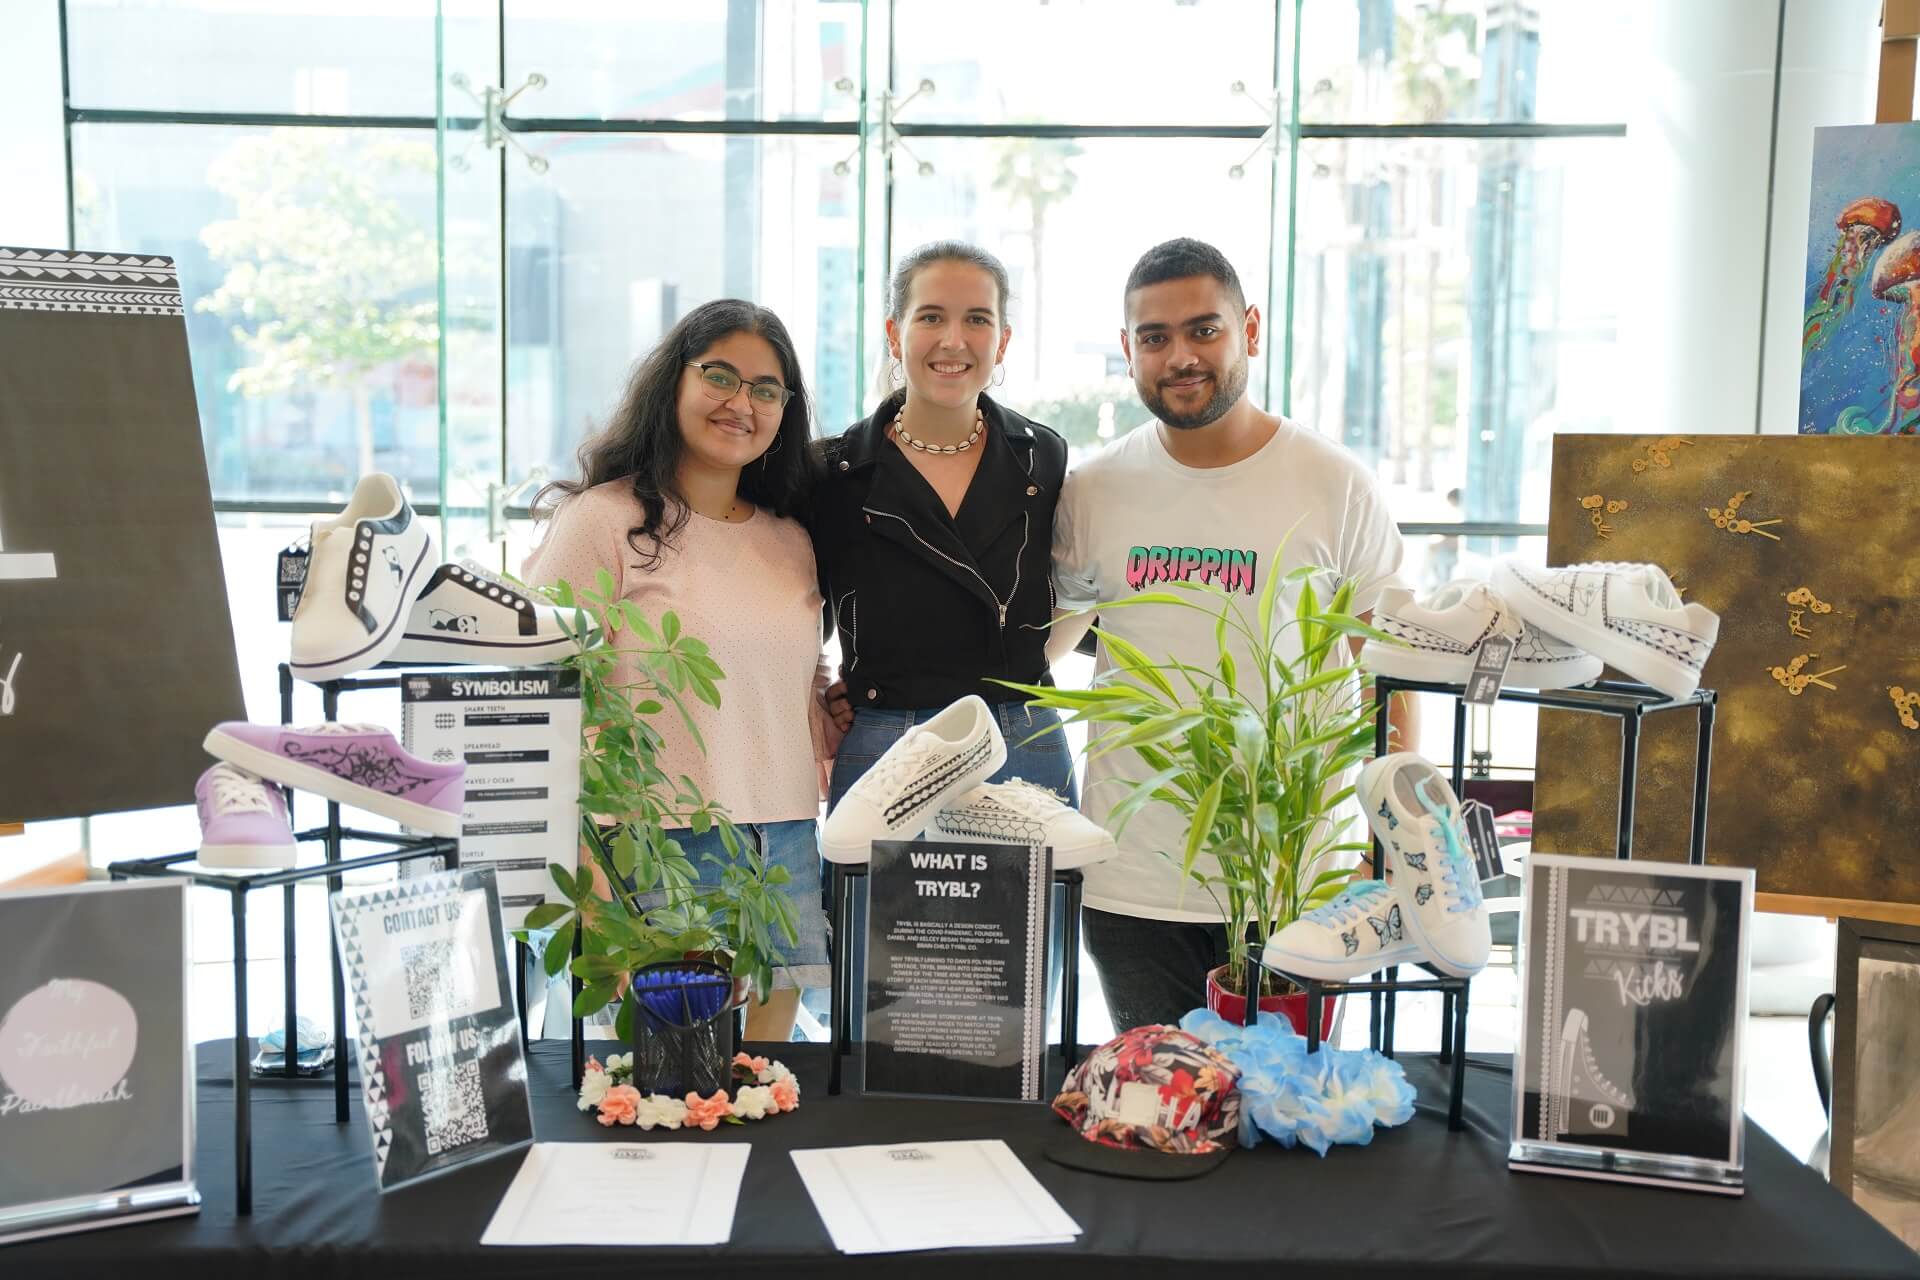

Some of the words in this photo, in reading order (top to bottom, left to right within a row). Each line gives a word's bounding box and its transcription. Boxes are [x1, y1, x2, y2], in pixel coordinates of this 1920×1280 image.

[1126, 546, 1257, 595] DRIPPIN
[452, 680, 549, 697] SYMBOLISM
[910, 852, 966, 870] WHAT
[971, 854, 988, 871] IS
[915, 880, 981, 898] TRYBL?
[384, 905, 440, 935] CONTACT
[1569, 908, 1700, 952] TRYBL
[1613, 960, 1685, 1007] Kicks
